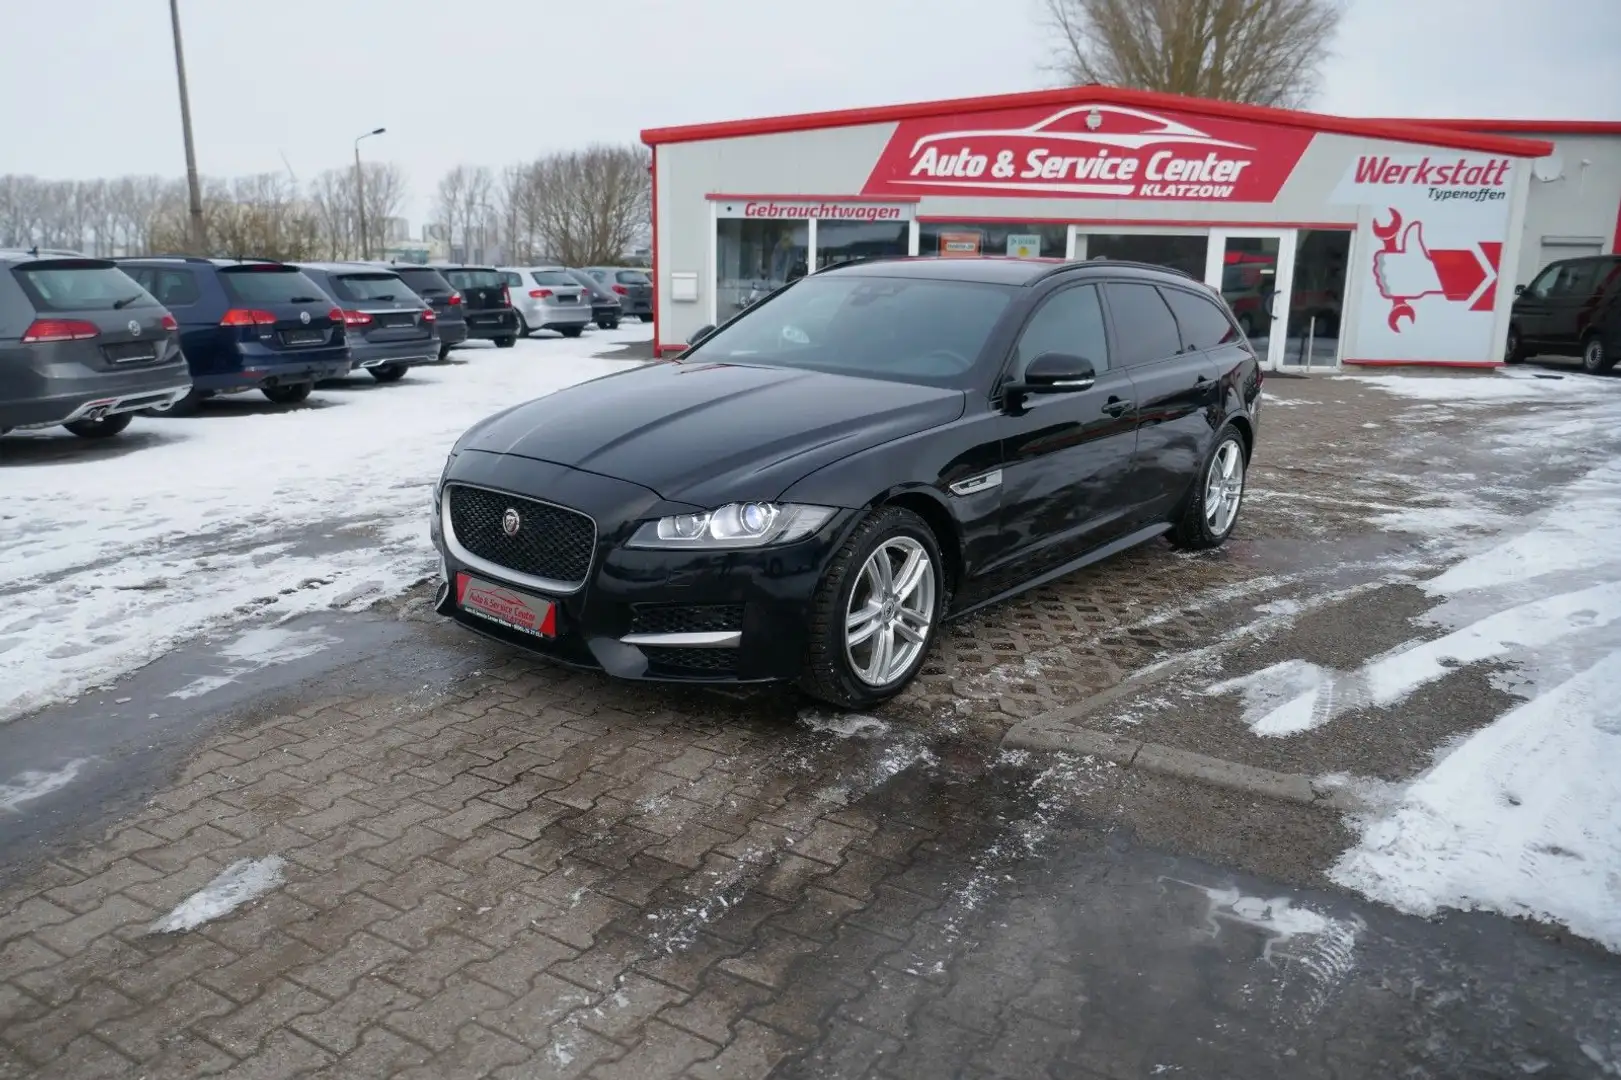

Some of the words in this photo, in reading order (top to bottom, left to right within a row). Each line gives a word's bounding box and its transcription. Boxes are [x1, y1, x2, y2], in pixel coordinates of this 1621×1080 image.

[910, 147, 988, 177] Auto
[991, 149, 1015, 177] &
[1021, 149, 1139, 180] Service
[1145, 151, 1251, 182] Center
[1354, 156, 1512, 186] Werkstatt
[1139, 184, 1234, 198] KLATZOW
[1428, 187, 1506, 201] Typenoffen
[744, 202, 901, 222] Gebrauchtwagen
[489, 598, 513, 614] Service
[514, 606, 536, 620] Center
